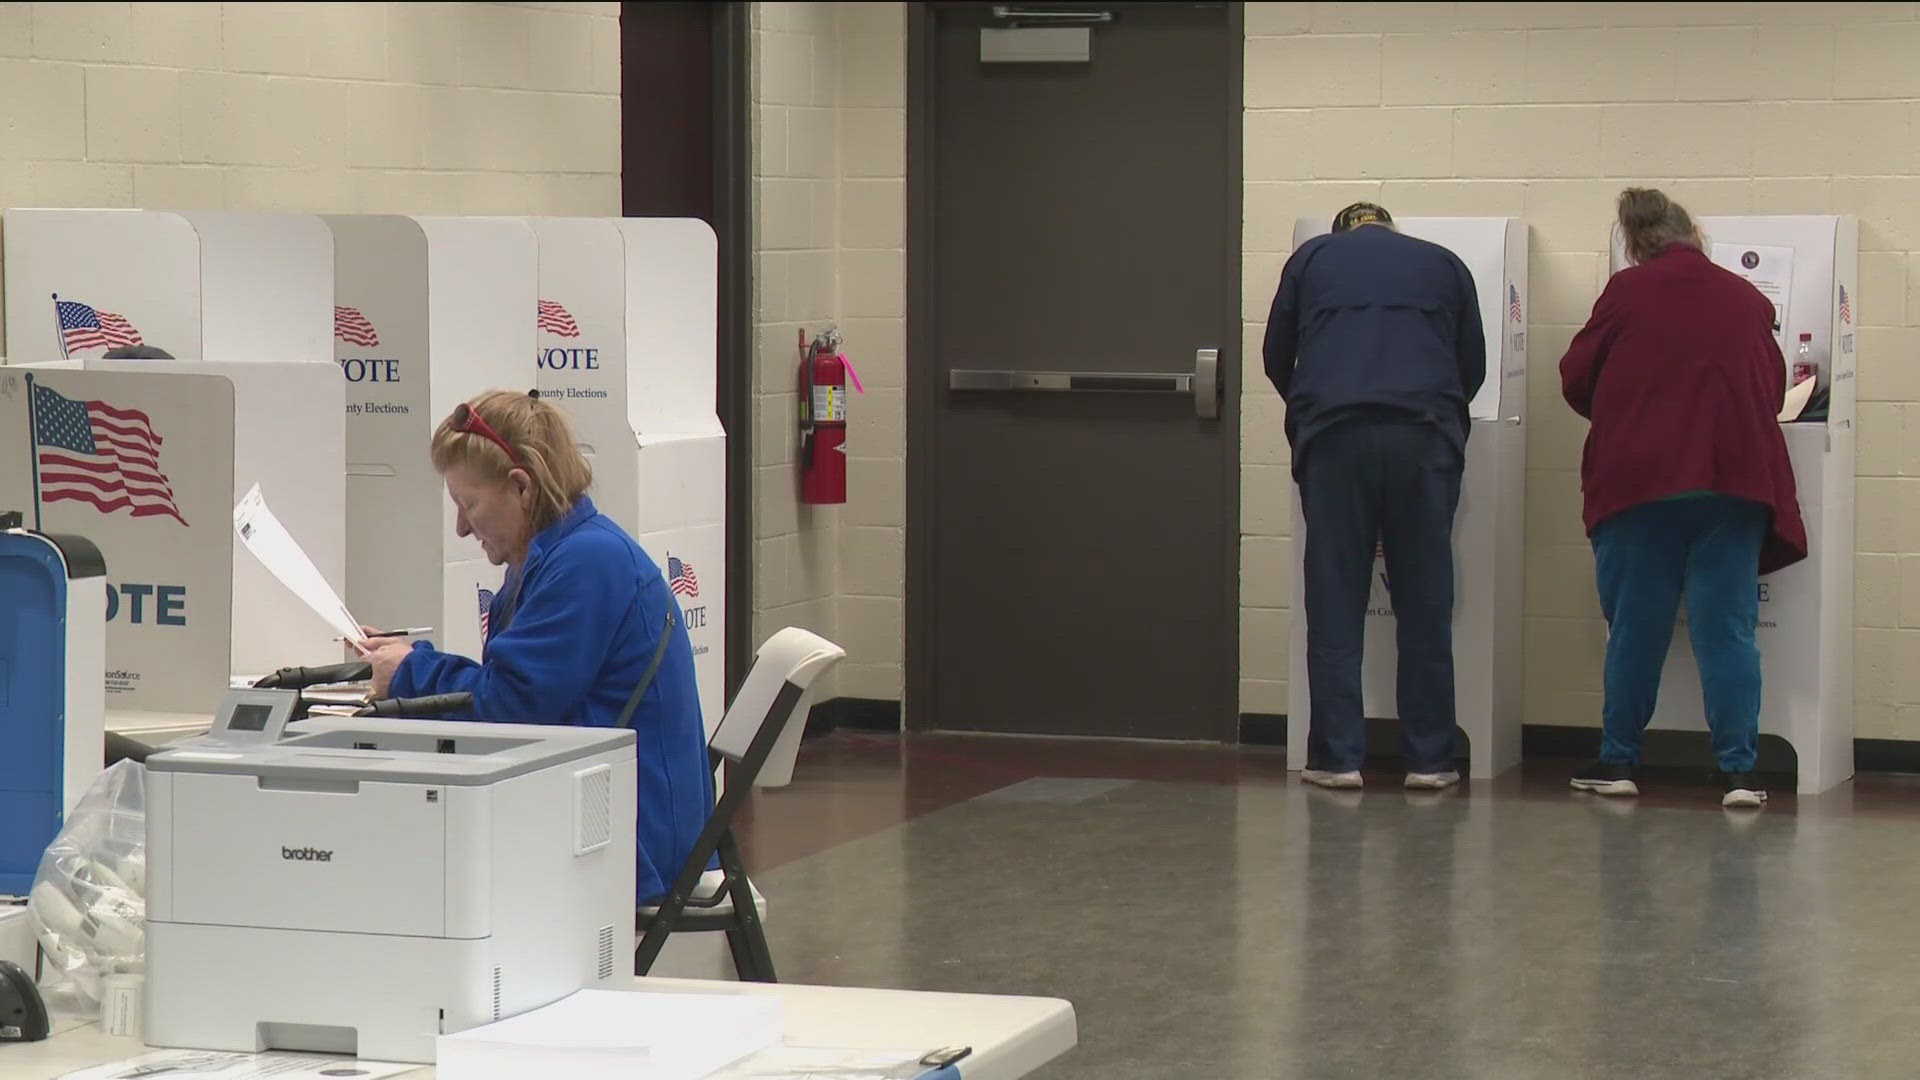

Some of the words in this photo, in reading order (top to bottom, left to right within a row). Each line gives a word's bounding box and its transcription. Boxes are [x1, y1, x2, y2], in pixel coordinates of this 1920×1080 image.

[341, 358, 400, 382] OTE
[567, 388, 608, 398] Elections
[365, 402, 409, 413] Elections
[684, 606, 706, 630] OTE
[282, 846, 333, 862] brother
